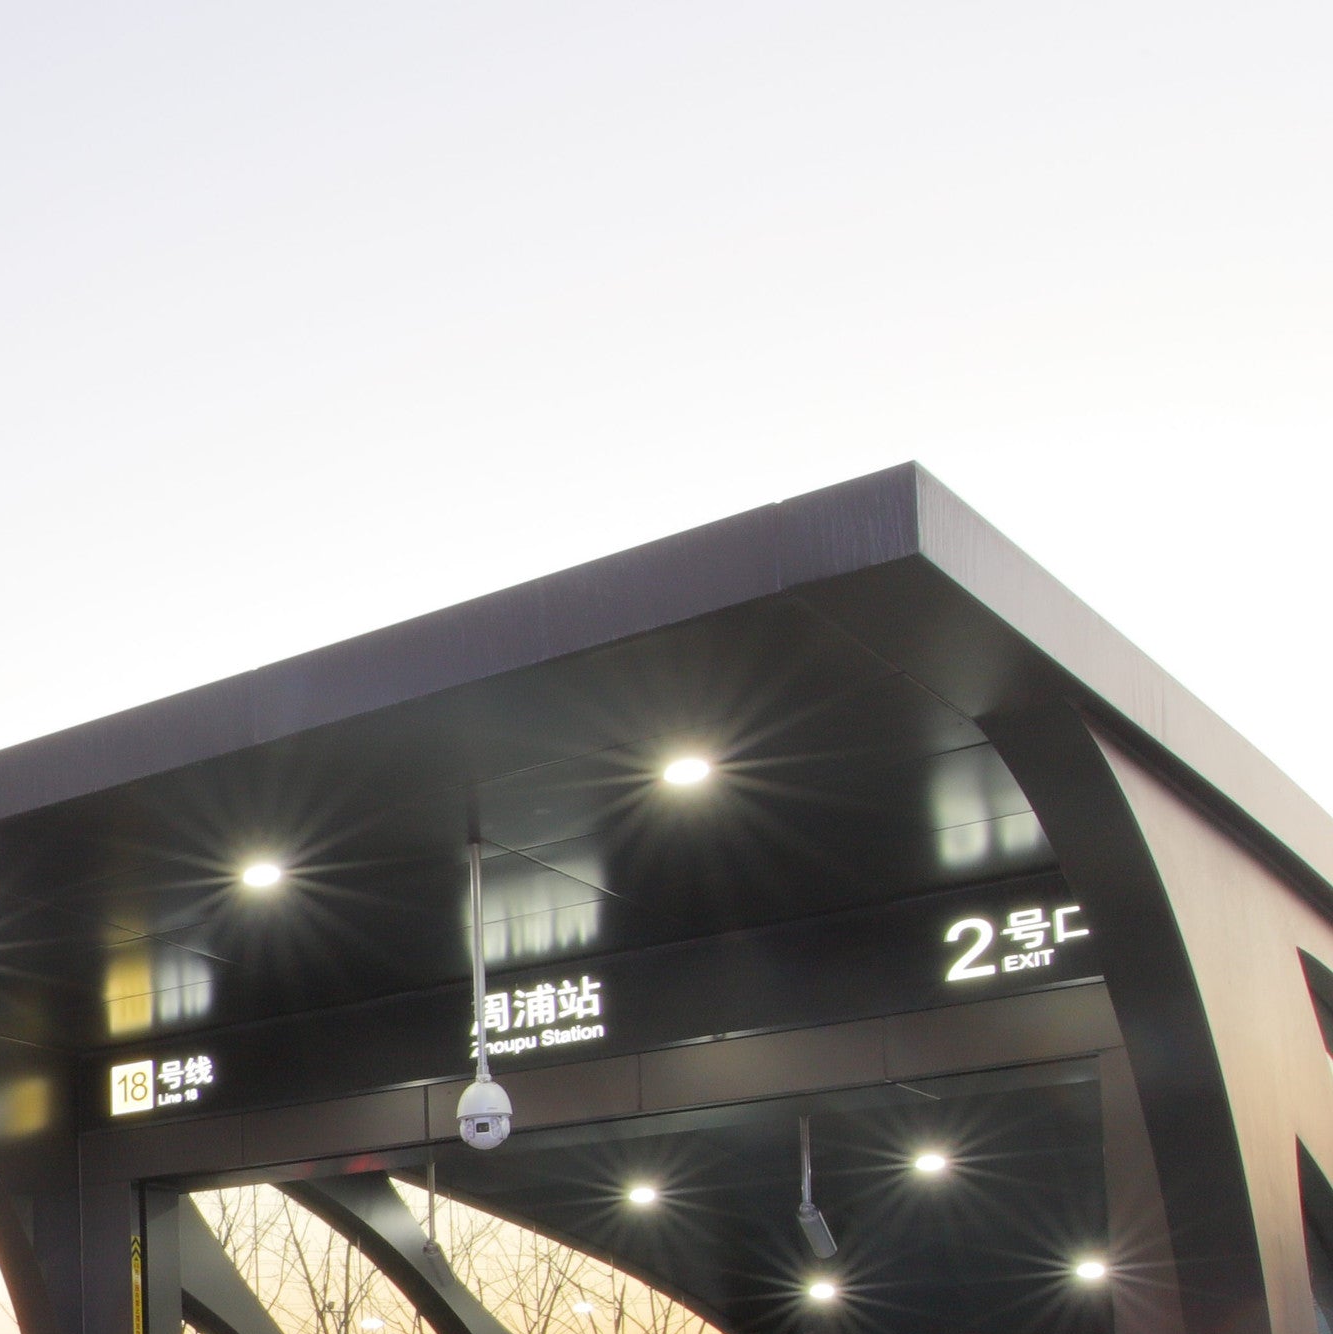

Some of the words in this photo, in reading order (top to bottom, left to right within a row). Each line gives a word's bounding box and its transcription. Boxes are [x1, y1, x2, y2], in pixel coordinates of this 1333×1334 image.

[1002, 949, 1055, 973] EXIT
[469, 975, 602, 1037] 周浦站
[541, 1024, 605, 1047] Station
[157, 1055, 214, 1090] 号线
[118, 1071, 148, 1103] 18
[157, 1092, 182, 1106] Line
[184, 1088, 199, 1101] 18
